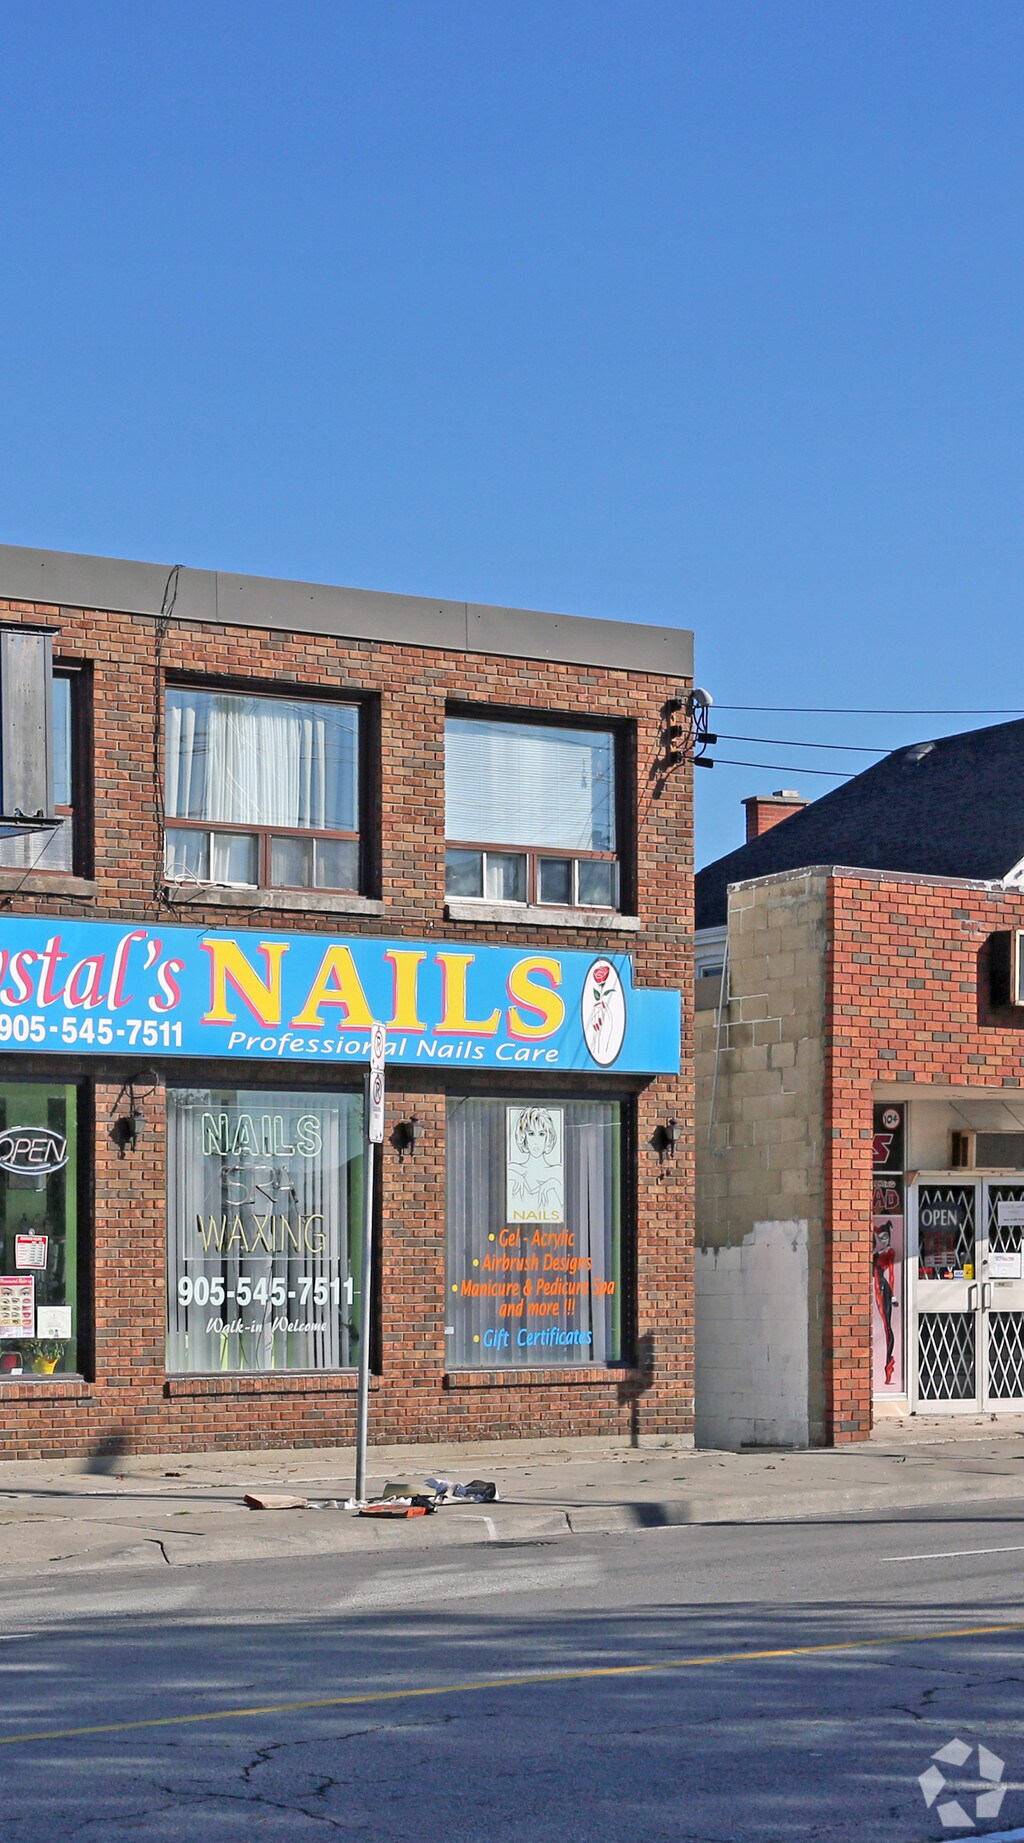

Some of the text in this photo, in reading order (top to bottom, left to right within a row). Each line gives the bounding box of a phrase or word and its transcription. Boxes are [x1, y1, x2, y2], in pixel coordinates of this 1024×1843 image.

[200, 938, 566, 1042] NAILS
[416, 1038, 485, 1061] Nails
[495, 1042, 560, 1063] Care
[201, 1112, 323, 1158] NAILS
[513, 1210, 560, 1221] NAILS
[921, 1209, 958, 1226] OPEN
[197, 1213, 327, 1253] WAXING
[499, 1228, 520, 1247] Gel
[532, 1228, 575, 1250] Acrylic
[481, 1253, 592, 1275] Airbrush Designs
[177, 1276, 354, 1307] 905-545-7511
[460, 1278, 615, 1298] Manicure & Pedicure Spa
[499, 1298, 575, 1317] and more !!!
[206, 1316, 327, 1334] Walk-in Welcome
[483, 1326, 592, 1350] Gift Certificates
